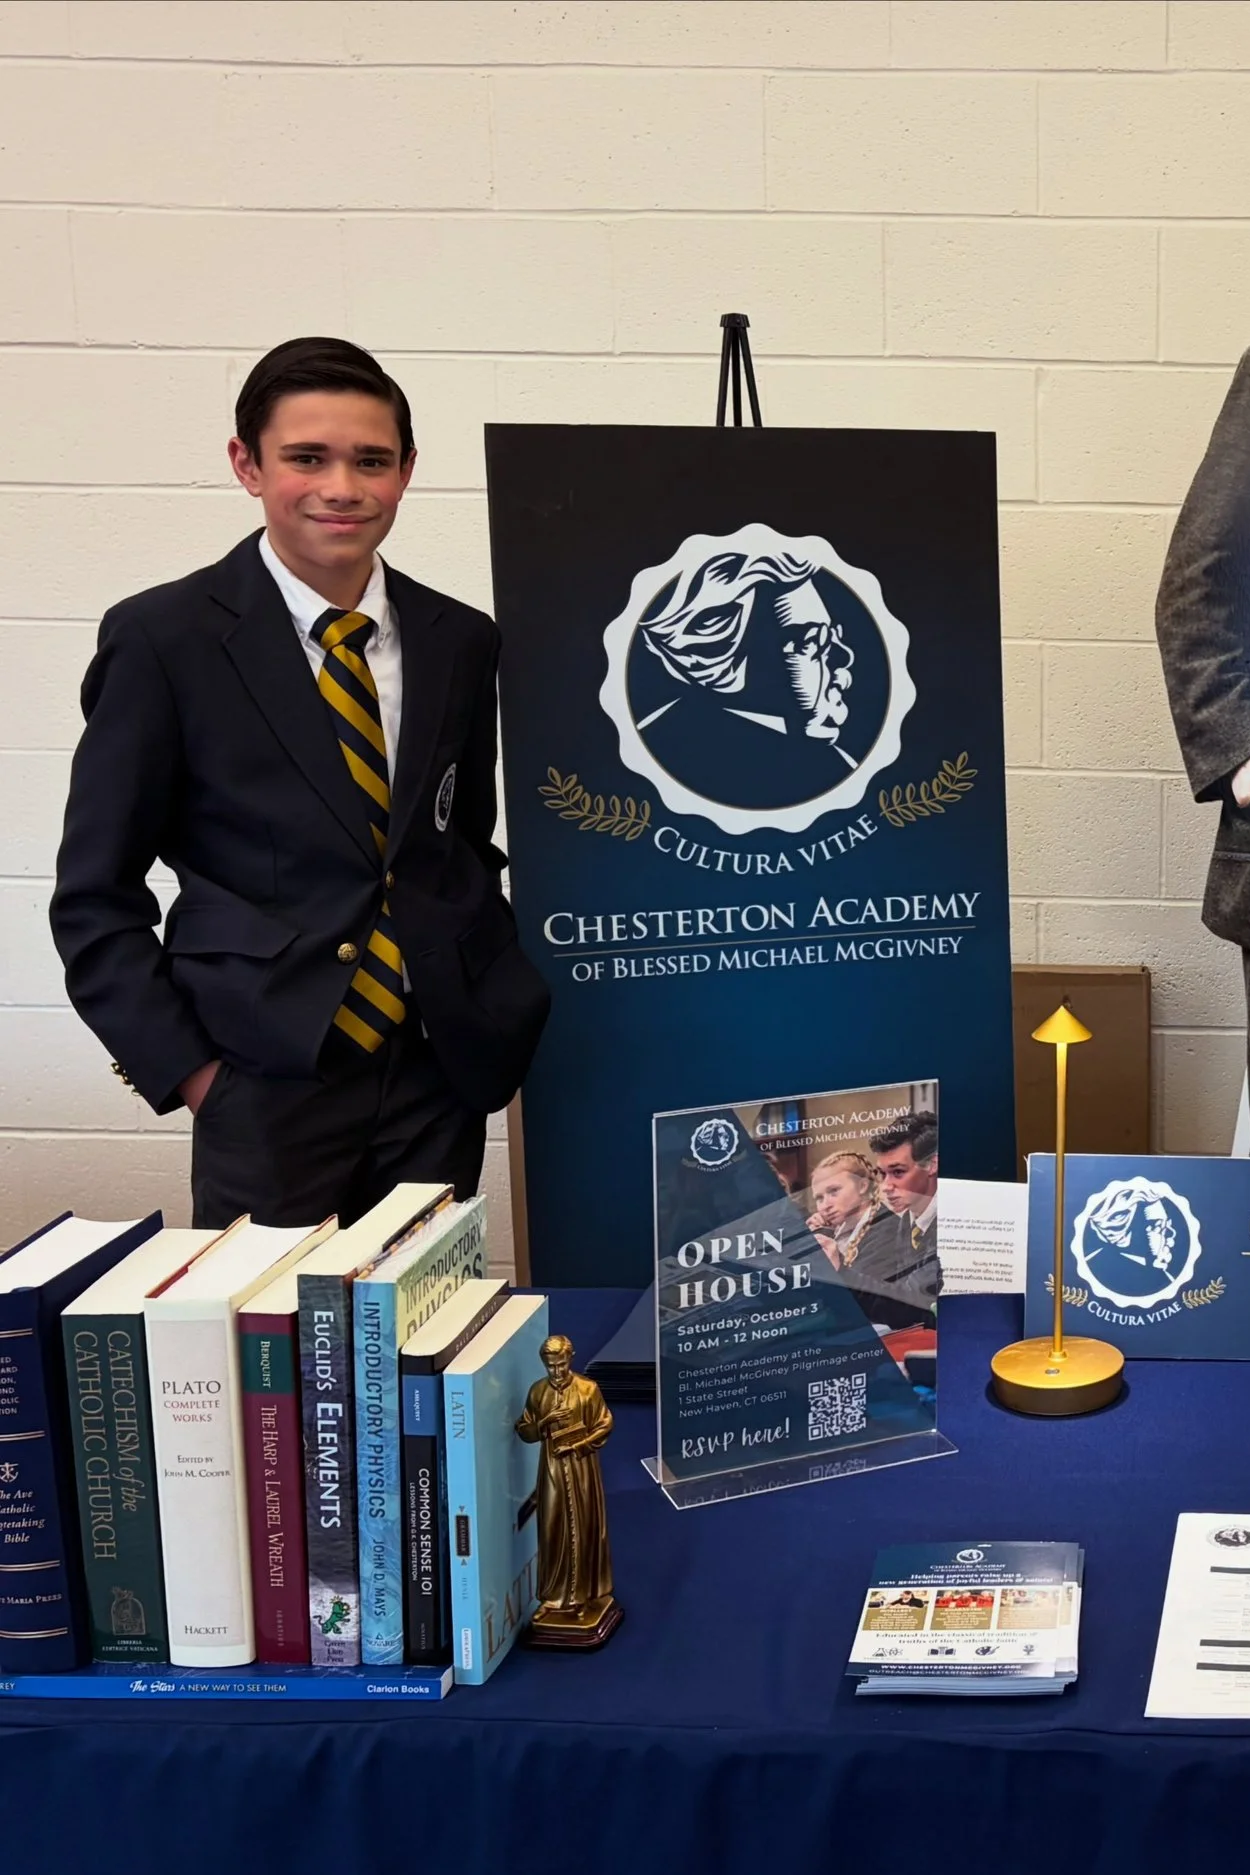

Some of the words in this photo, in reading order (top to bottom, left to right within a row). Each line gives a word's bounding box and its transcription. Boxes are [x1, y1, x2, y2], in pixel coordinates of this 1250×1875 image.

[653, 826, 793, 876] CULTURA
[797, 813, 879, 867] VITAE
[543, 902, 795, 946] CHESTERTON
[807, 892, 981, 928] ACADEMY
[572, 961, 605, 982] OF
[613, 953, 711, 979] BLESSED
[718, 945, 829, 970] MICHAEL
[756, 1115, 845, 1137] CHESTERTON
[852, 1105, 912, 1123] ACADEMY
[760, 1141, 774, 1151] OF
[775, 1136, 813, 1150] BLESSED
[815, 1131, 857, 1146] MICHAEL
[677, 1228, 785, 1268] OPEN
[406, 1219, 483, 1314] INTRODUCTORY
[679, 1262, 812, 1309] HOUSE
[677, 1314, 746, 1337] Saturday,
[750, 1306, 806, 1325] October
[811, 1303, 819, 1314] 3
[1087, 1300, 1144, 1326] CULTURA
[1146, 1301, 1182, 1323] VITAE
[313, 1310, 334, 1391] EUCLID'S
[677, 1342, 692, 1353] 10
[697, 1337, 720, 1350] AM
[733, 1332, 747, 1344] 12
[751, 1325, 788, 1341] Noon
[260, 1340, 271, 1388] BERQUIST
[363, 1302, 384, 1439] INTRODUCTORY
[678, 1363, 737, 1380] Chesterton
[740, 1353, 788, 1371] Academy
[791, 1350, 802, 1359] at
[804, 1346, 822, 1358] the
[695, 1374, 737, 1391] Michael
[739, 1365, 790, 1384] McGivney
[792, 1356, 849, 1374] Pilgrimage
[850, 1347, 884, 1361] Center
[74, 1331, 107, 1452] CATHOLIC
[107, 1331, 140, 1462] CATECHISM
[162, 1380, 221, 1394] PLATO
[679, 1397, 683, 1406] 1
[686, 1392, 713, 1404] State
[715, 1386, 748, 1399] Street
[163, 1400, 220, 1410] COMPLETE
[172, 1412, 213, 1423] WORKS
[261, 1405, 277, 1428] THE
[451, 1391, 465, 1439] LATIN
[679, 1408, 703, 1419] New
[706, 1401, 742, 1415] Haven,
[745, 1396, 757, 1407] CT
[760, 1390, 787, 1403] 06511
[263, 1430, 279, 1466] HARP
[741, 1416, 791, 1447] here!
[113, 1466, 145, 1487] of
[317, 1403, 343, 1529] ELEMENTS
[366, 1444, 384, 1519] PHYSICS
[13, 1490, 33, 1499] Ave
[86, 1457, 117, 1559] CHURCH
[121, 1487, 146, 1512] the
[265, 1481, 281, 1528] LAUREL
[419, 1468, 431, 1529] COMMON
[4, 1533, 30, 1543] Bible
[373, 1540, 385, 1567] JOHN
[420, 1534, 431, 1571] SENSE
[269, 1532, 284, 1588] WREATH
[374, 1573, 385, 1584] D.
[6, 1596, 33, 1604] MARIA
[36, 1593, 62, 1603] PRESS
[374, 1588, 386, 1616] MAYS
[184, 1624, 228, 1635] HACKETT
[130, 1680, 147, 1692] The
[150, 1681, 176, 1692] Stars
[188, 1684, 209, 1692] NEW
[212, 1684, 231, 1692] WAY
[233, 1684, 243, 1692] TO
[246, 1684, 262, 1692] SEE
[264, 1684, 287, 1692] THEM
[367, 1684, 398, 1694] Clarion
[401, 1684, 430, 1695] Books
